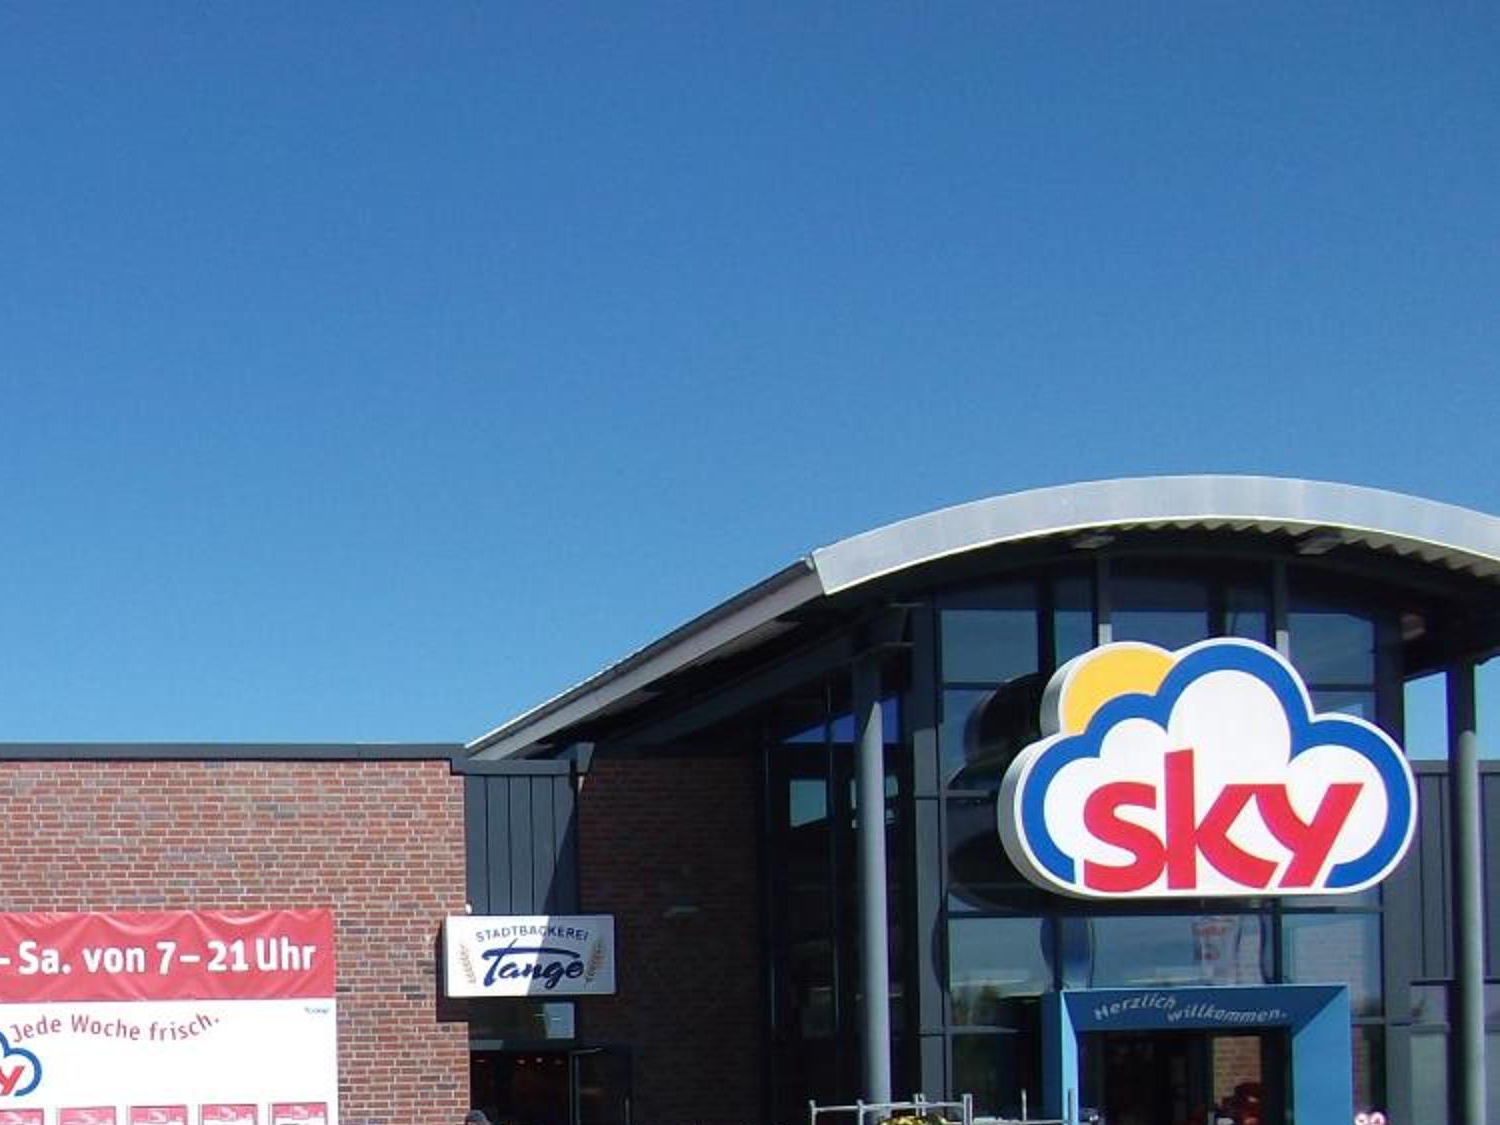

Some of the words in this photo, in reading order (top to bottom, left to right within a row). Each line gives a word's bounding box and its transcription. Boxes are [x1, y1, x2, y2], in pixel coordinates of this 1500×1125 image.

[1083, 749, 1364, 892] sky
[19, 941, 71, 975] Sa.
[83, 946, 145, 974] von
[256, 937, 317, 972] Uhr
[481, 938, 585, 989] Tange
[1093, 992, 1177, 1020] Herzlich
[1166, 1002, 1288, 1024] willkommen.
[9, 1015, 61, 1044] Jede
[71, 1015, 140, 1041] Woche
[149, 1012, 221, 1043] frisch.
